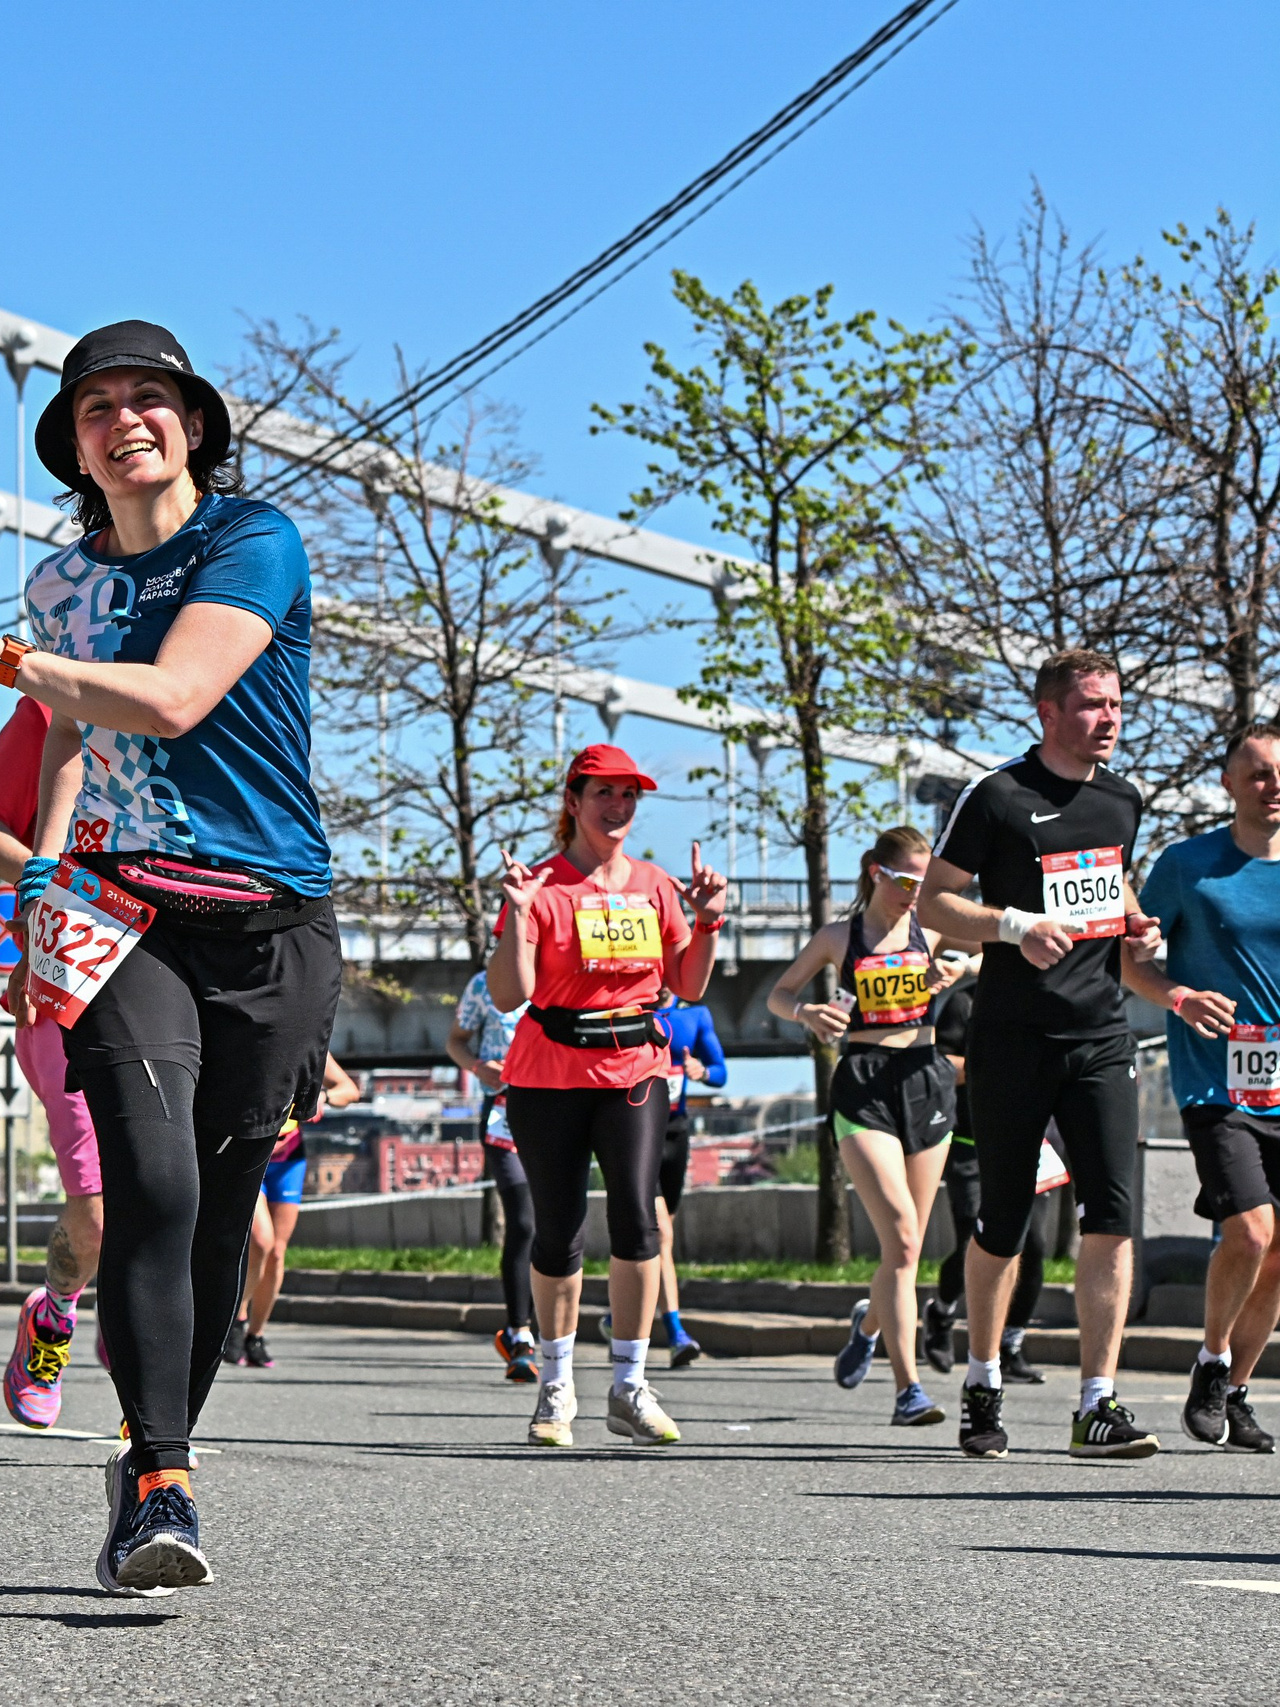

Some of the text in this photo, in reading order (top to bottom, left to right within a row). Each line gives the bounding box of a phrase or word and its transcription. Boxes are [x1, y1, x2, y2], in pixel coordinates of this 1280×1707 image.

[1048, 874, 1120, 908] 10506
[591, 918, 648, 942] 4681
[1232, 1049, 1280, 1076] 103
[1247, 1076, 1276, 1086] ВЛАД
